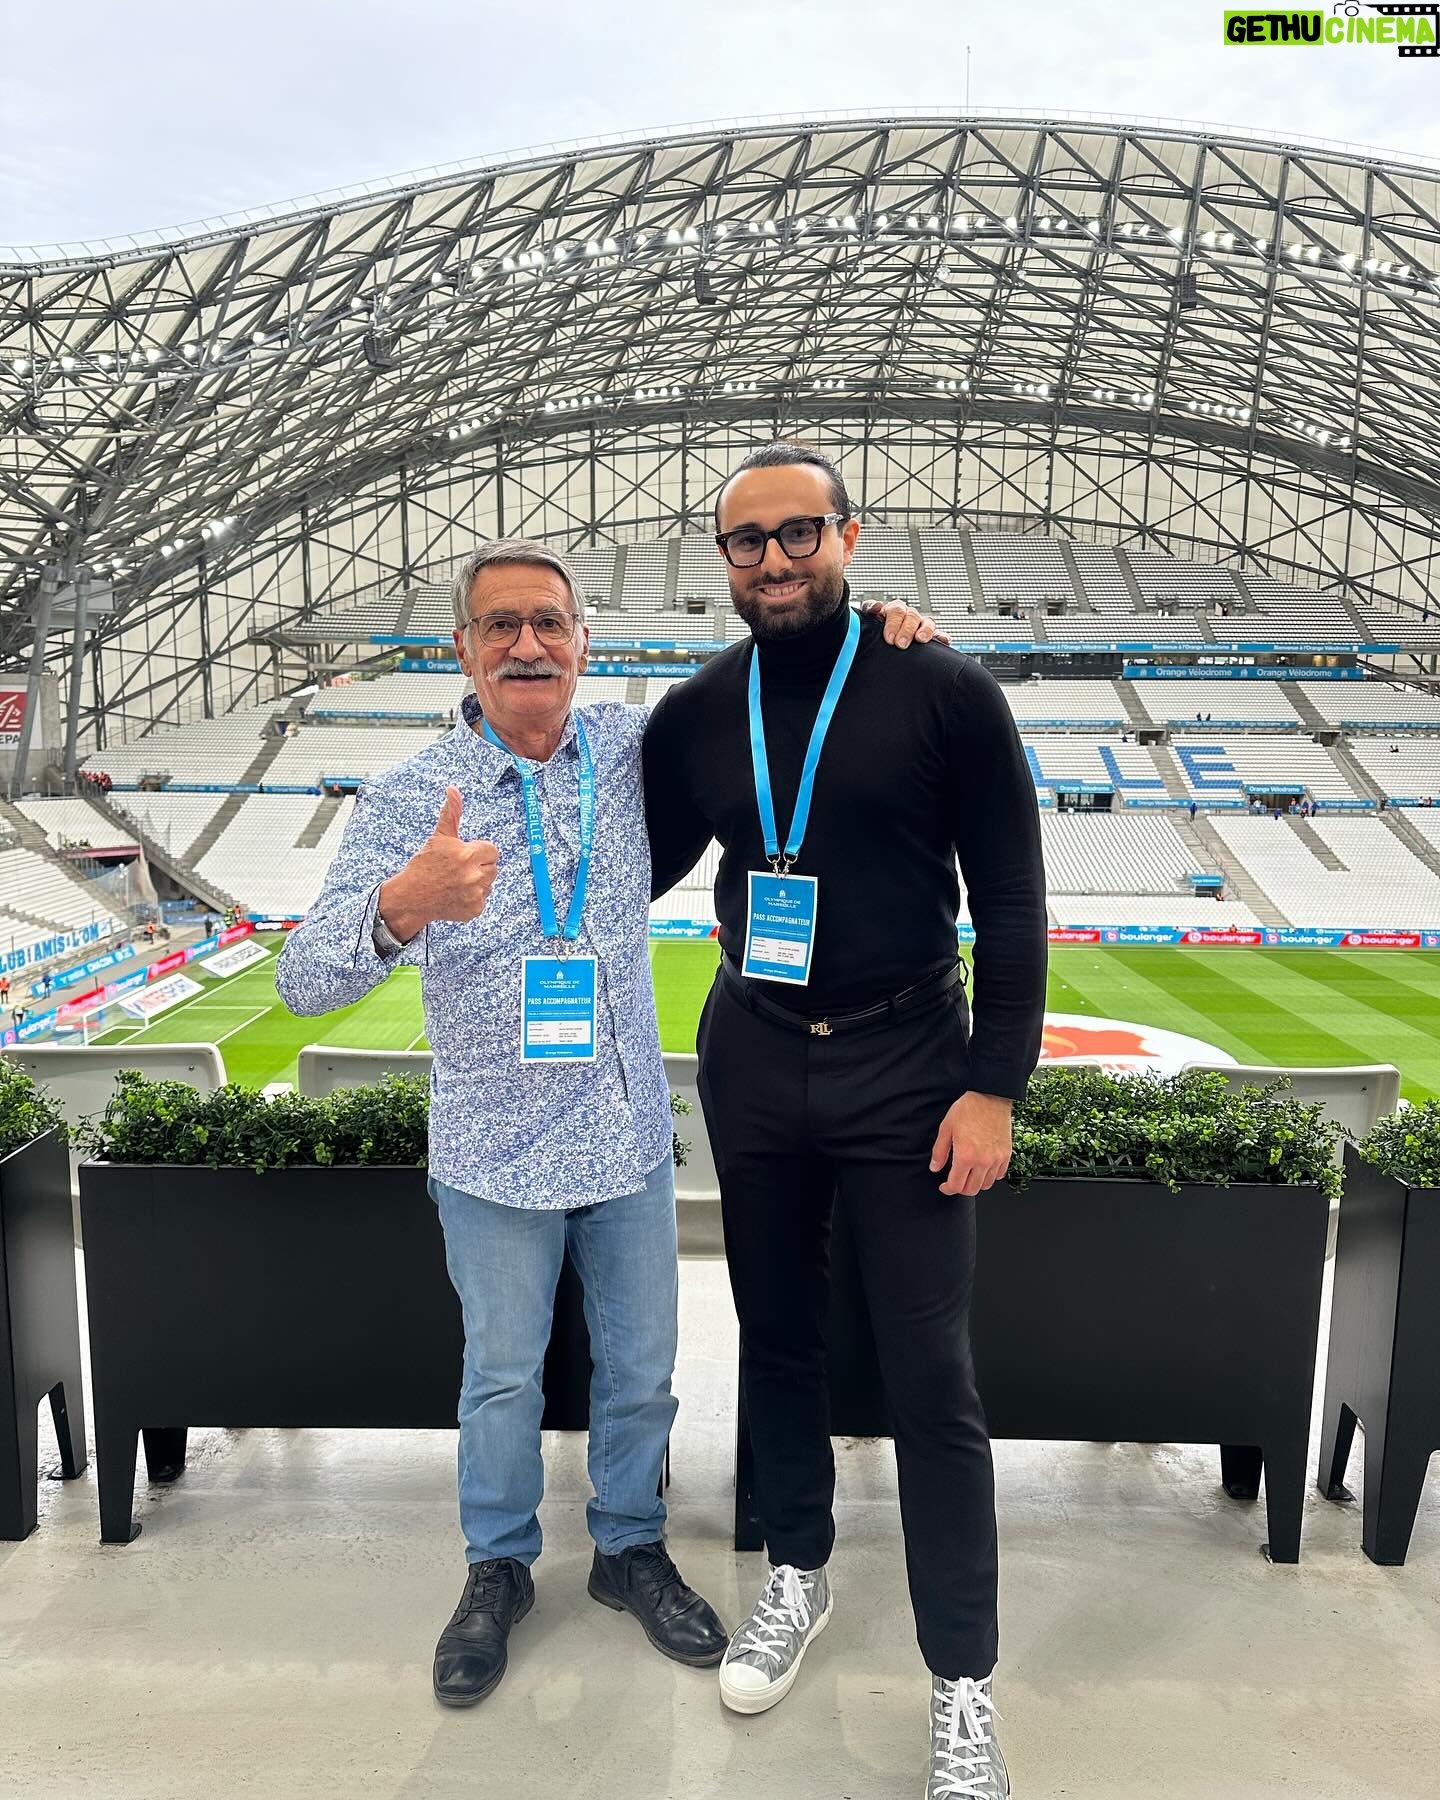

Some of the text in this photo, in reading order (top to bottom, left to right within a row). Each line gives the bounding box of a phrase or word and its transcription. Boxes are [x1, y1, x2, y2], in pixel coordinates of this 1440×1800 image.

[427, 661, 457, 671] Orange
[622, 665, 652, 674] Orange
[1156, 668, 1187, 677] Orange
[1256, 669, 1287, 678] Orange
[581, 777, 592, 790] DE
[522, 768, 541, 841] DE MARSEILLE
[580, 793, 592, 845] OLYMPIQUE
[753, 913, 810, 926] PASS ACCOMPAGNATEUR
[1120, 932, 1174, 943] boulanger
[1203, 933, 1257, 944] boulanger
[1280, 935, 1334, 945] boulanger
[1363, 935, 1416, 946] boulanger
[34, 936, 65, 961] AMIS
[527, 997, 591, 1005] PASS ACCOMPAGNATEUR
